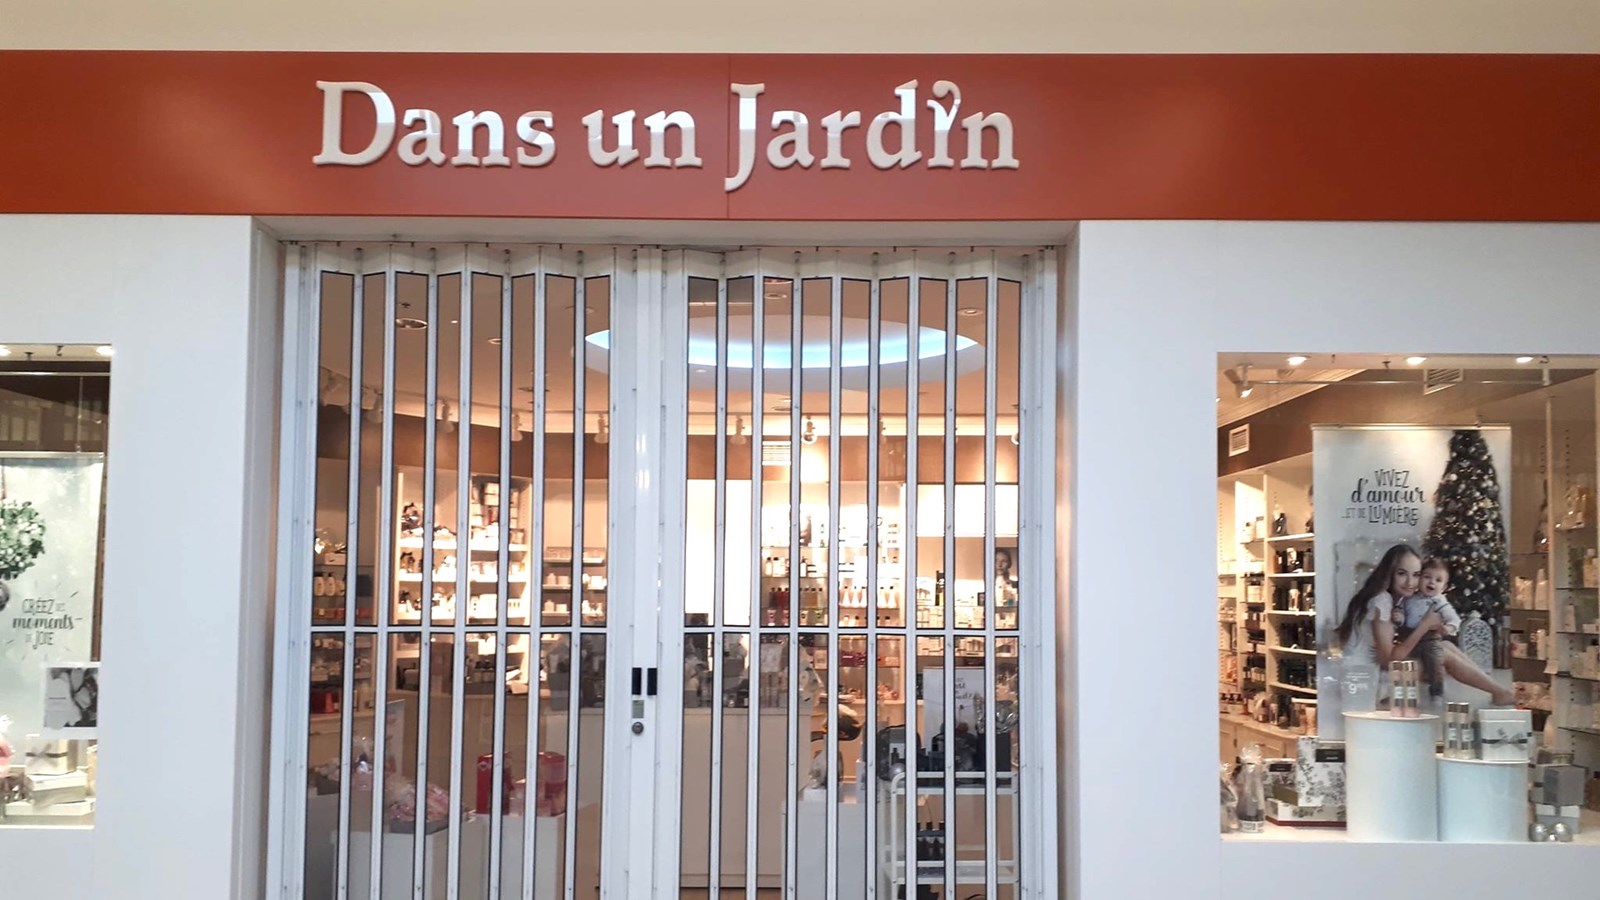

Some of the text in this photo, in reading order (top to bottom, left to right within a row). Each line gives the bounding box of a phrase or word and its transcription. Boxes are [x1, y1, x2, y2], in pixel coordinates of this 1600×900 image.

[312, 79, 1020, 192] Dans un Jardin
[1374, 468, 1409, 489] VIVEZ
[1351, 478, 1425, 503] d'amour
[12, 614, 74, 630] moments
